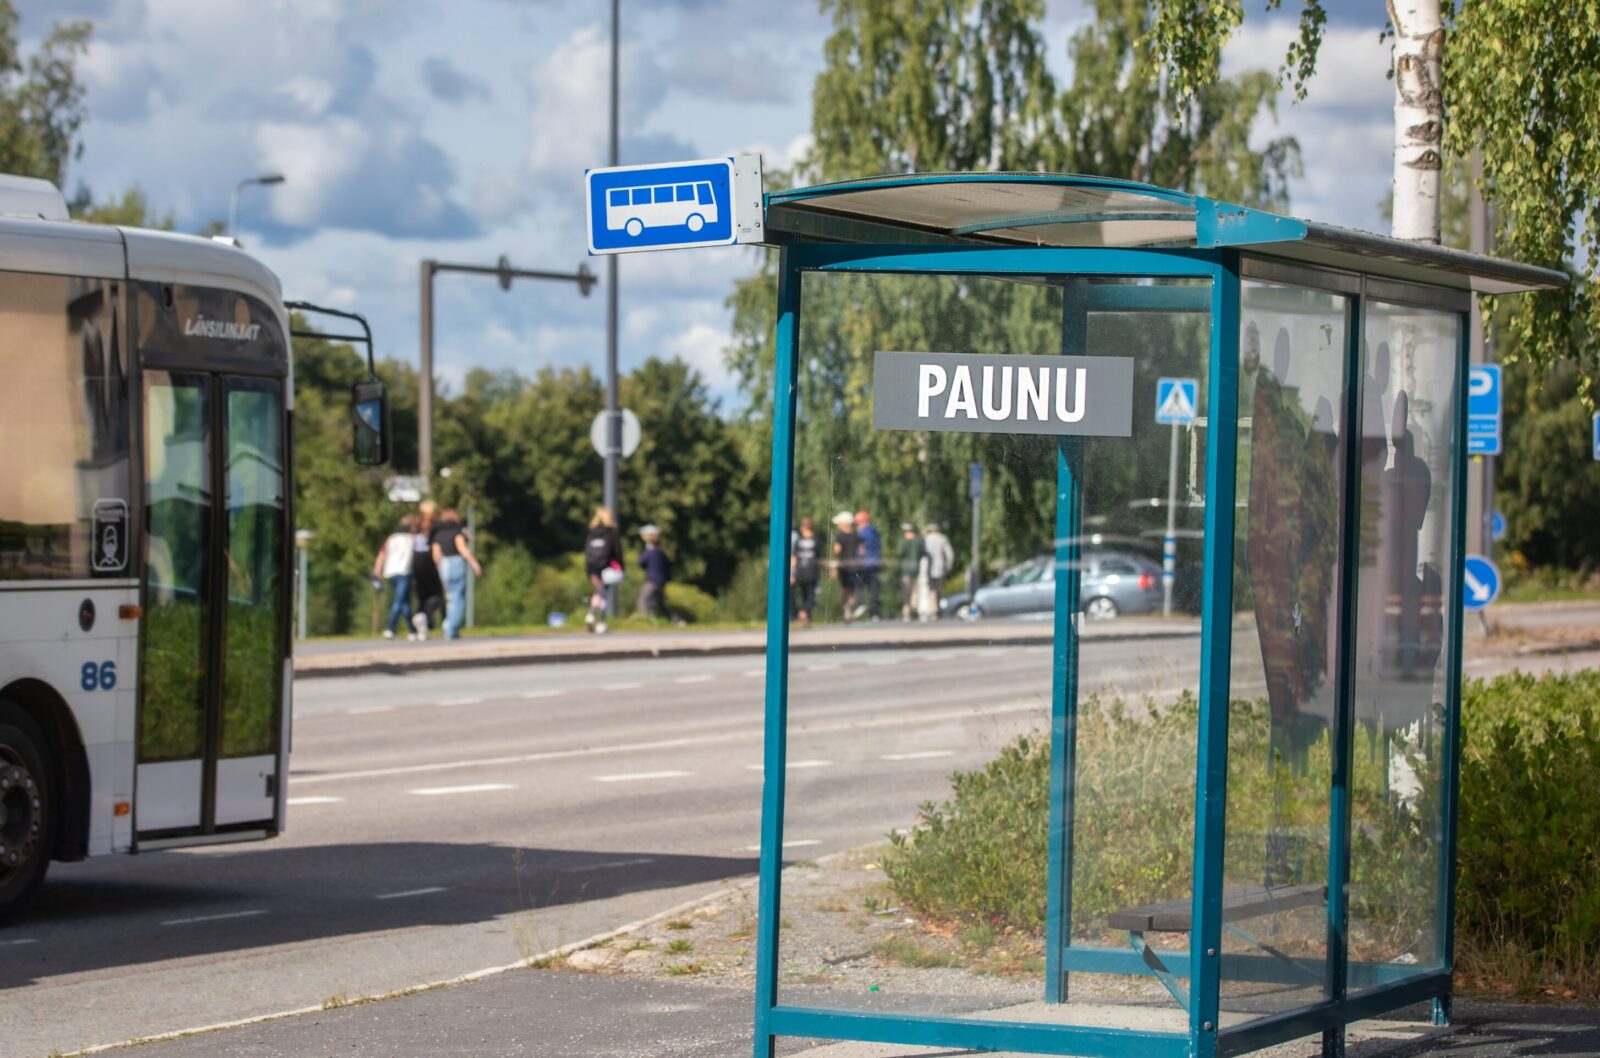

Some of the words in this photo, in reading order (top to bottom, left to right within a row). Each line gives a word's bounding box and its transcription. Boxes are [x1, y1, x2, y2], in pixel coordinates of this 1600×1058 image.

[184, 315, 261, 341] LÄNSILINJAT
[917, 364, 1087, 423] PAUNU
[81, 660, 117, 692] 86
